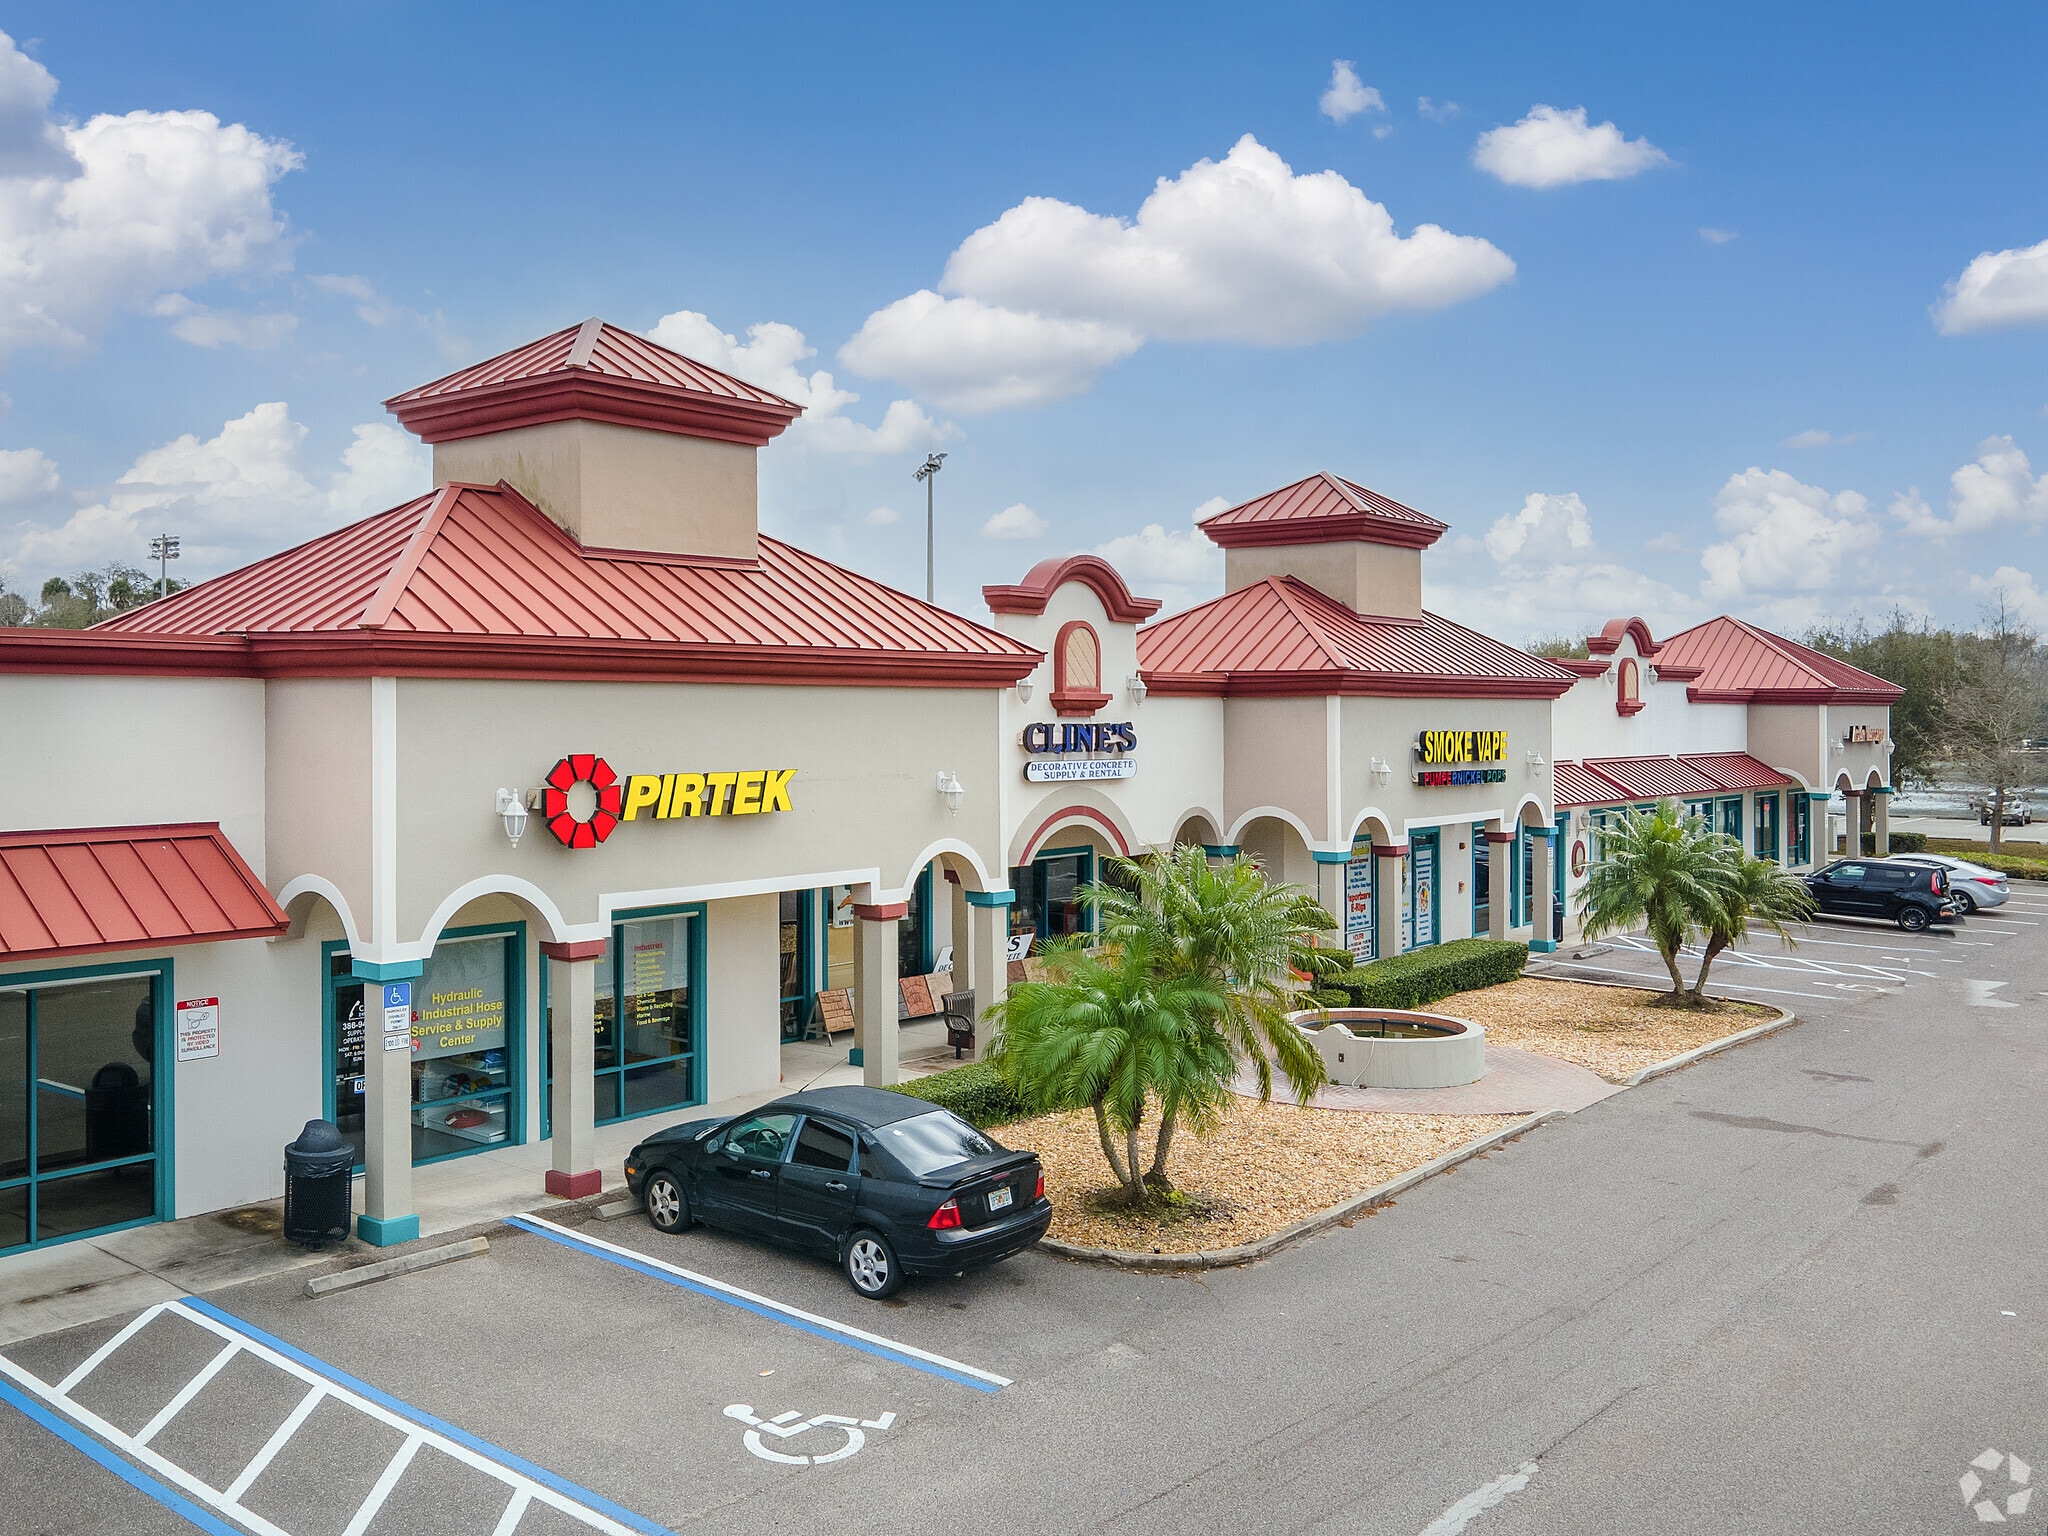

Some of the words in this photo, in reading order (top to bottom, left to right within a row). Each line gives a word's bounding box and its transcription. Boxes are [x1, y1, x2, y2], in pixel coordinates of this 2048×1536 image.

[1023, 722, 1137, 754] CLINE'S
[1421, 730, 1472, 763] SMOKE
[1476, 731, 1508, 762] VAPE
[1031, 762, 1088, 771] DECORATIVE
[1090, 761, 1133, 769] CONCRETE
[1044, 771, 1077, 779] SUPPLY
[1080, 770, 1086, 778] &
[1089, 769, 1122, 777] RENTAL
[1423, 769, 1484, 786] PUMPERNICKEL
[618, 769, 798, 821] PIRTEK
[186, 999, 209, 1007] NOTICE
[432, 987, 483, 1006] Hydraulic
[411, 1010, 419, 1022] &
[422, 1002, 473, 1021] Industrial
[476, 1000, 503, 1013] Hose
[411, 1022, 452, 1037] Service
[455, 1019, 463, 1031] &
[466, 1014, 502, 1030] Supply
[440, 1034, 476, 1048] Center
